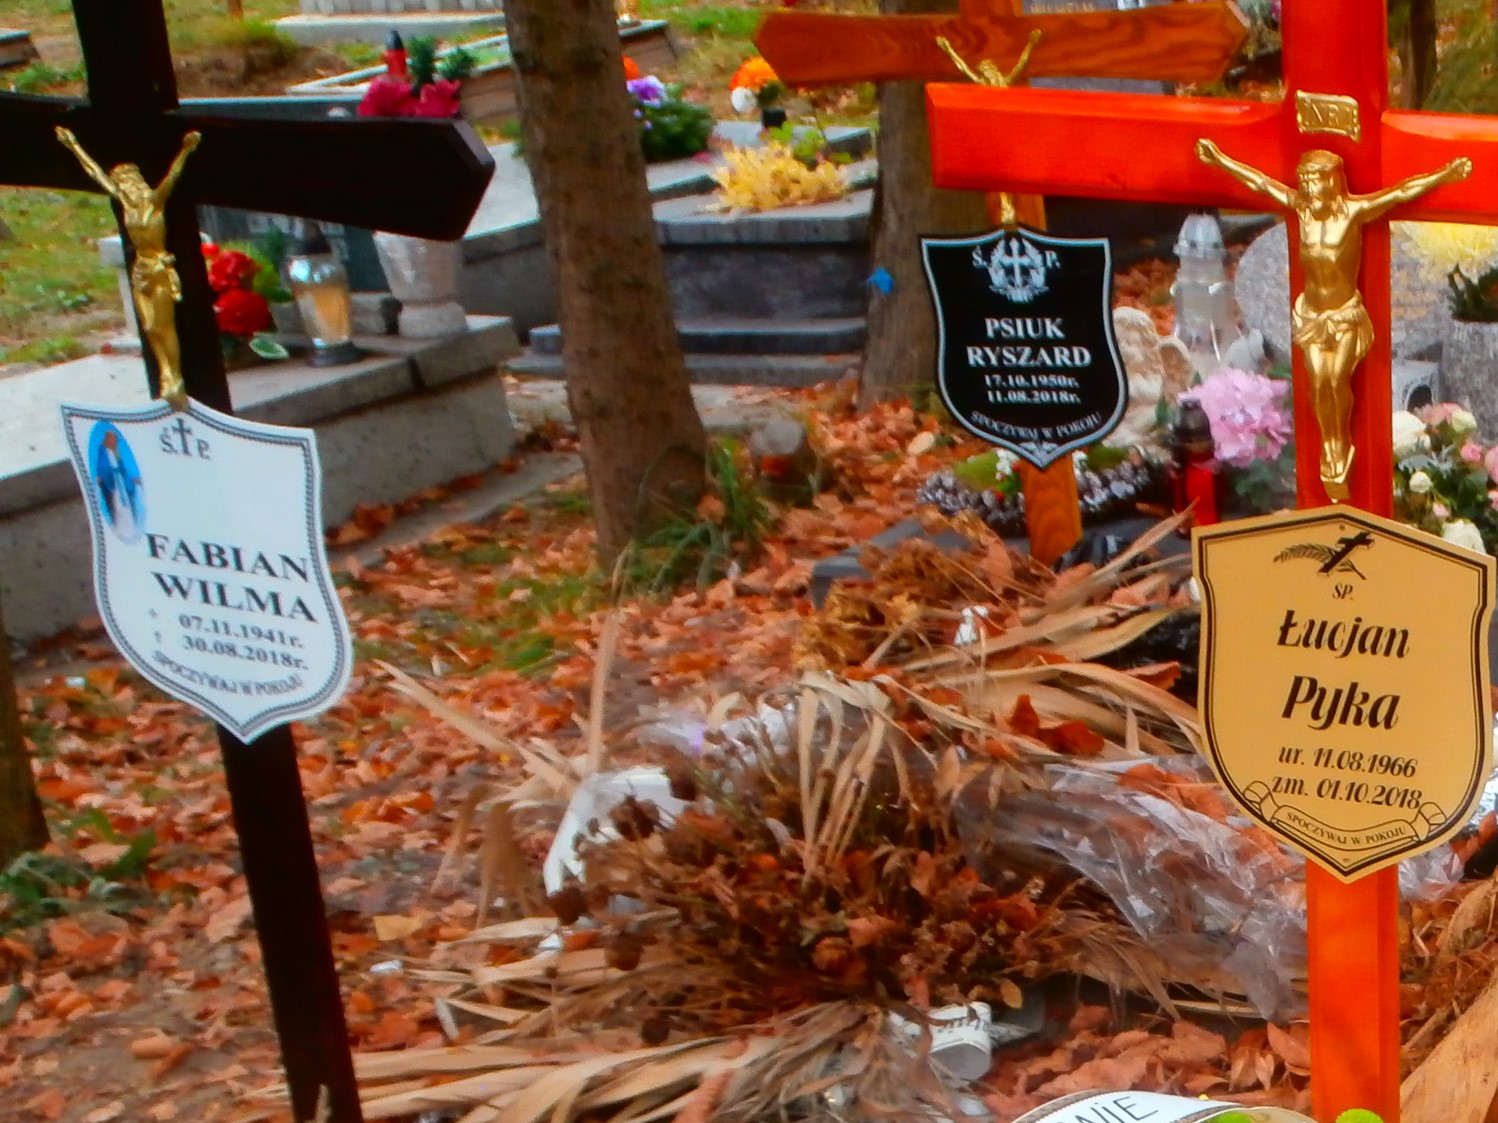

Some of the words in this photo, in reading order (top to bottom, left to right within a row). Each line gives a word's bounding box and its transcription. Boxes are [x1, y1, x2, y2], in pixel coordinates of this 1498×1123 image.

[984, 317, 1065, 339] PSIUK
[966, 346, 1092, 368] RYSZARD
[145, 533, 310, 583] FABIAN
[151, 571, 320, 624] WILMA
[1277, 609, 1411, 659] Łucjan
[1281, 675, 1401, 731] Pyka
[1277, 745, 1305, 766] ur.
[1313, 749, 1419, 779] 11.08.1966
[1271, 775, 1309, 797] zm.
[1316, 777, 1424, 810] 01.10.2018
[1286, 812, 1347, 845] SPOCZYWAJ
[1351, 836, 1362, 845] W
[1365, 827, 1407, 844] POKOJU
